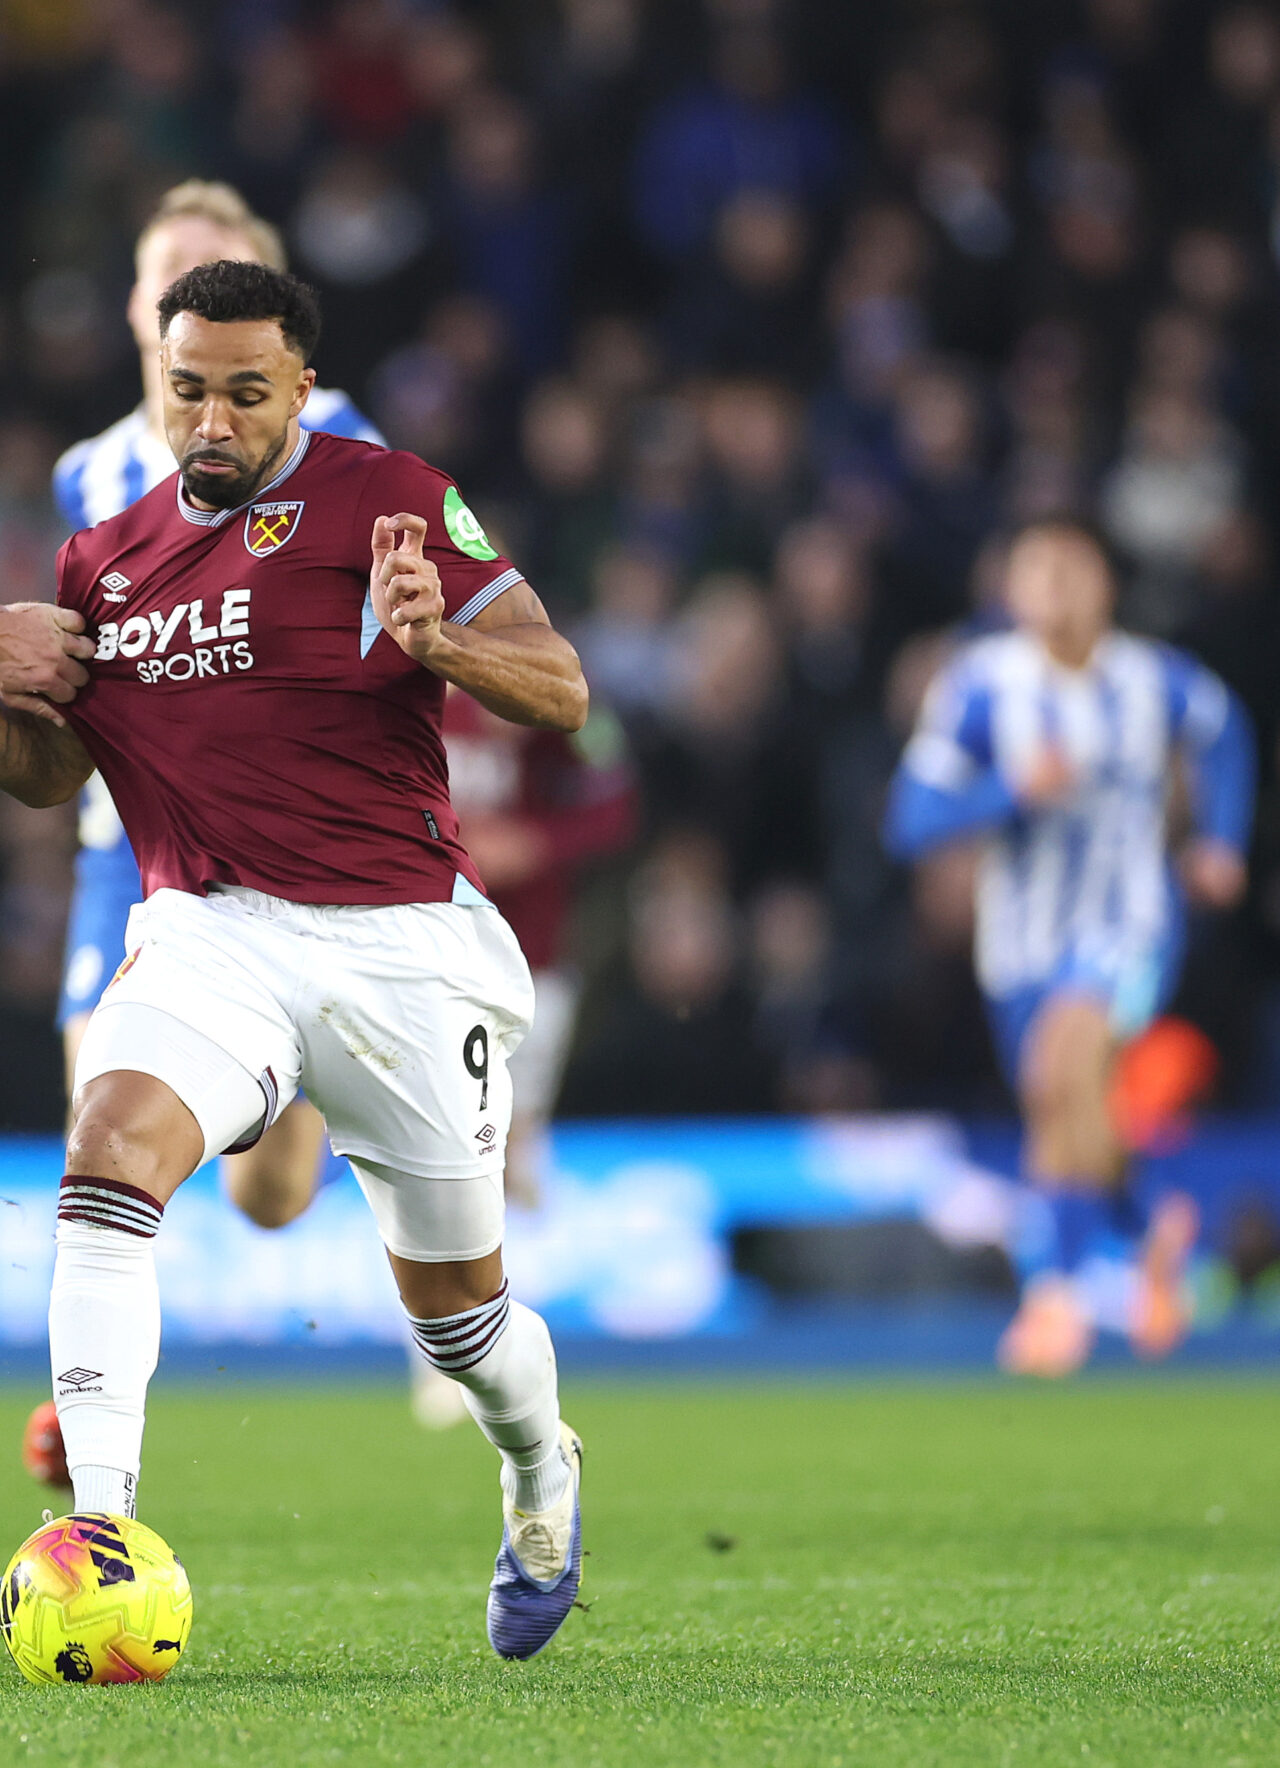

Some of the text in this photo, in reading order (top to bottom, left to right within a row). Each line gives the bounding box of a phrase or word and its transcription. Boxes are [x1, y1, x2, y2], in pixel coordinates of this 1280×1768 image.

[254, 505, 276, 515] WEST
[261, 509, 288, 517] UNITED
[93, 588, 251, 661] BOYLE
[136, 640, 254, 684] SPORTS
[463, 1024, 488, 1112] 9
[59, 1385, 103, 1396] umbro
